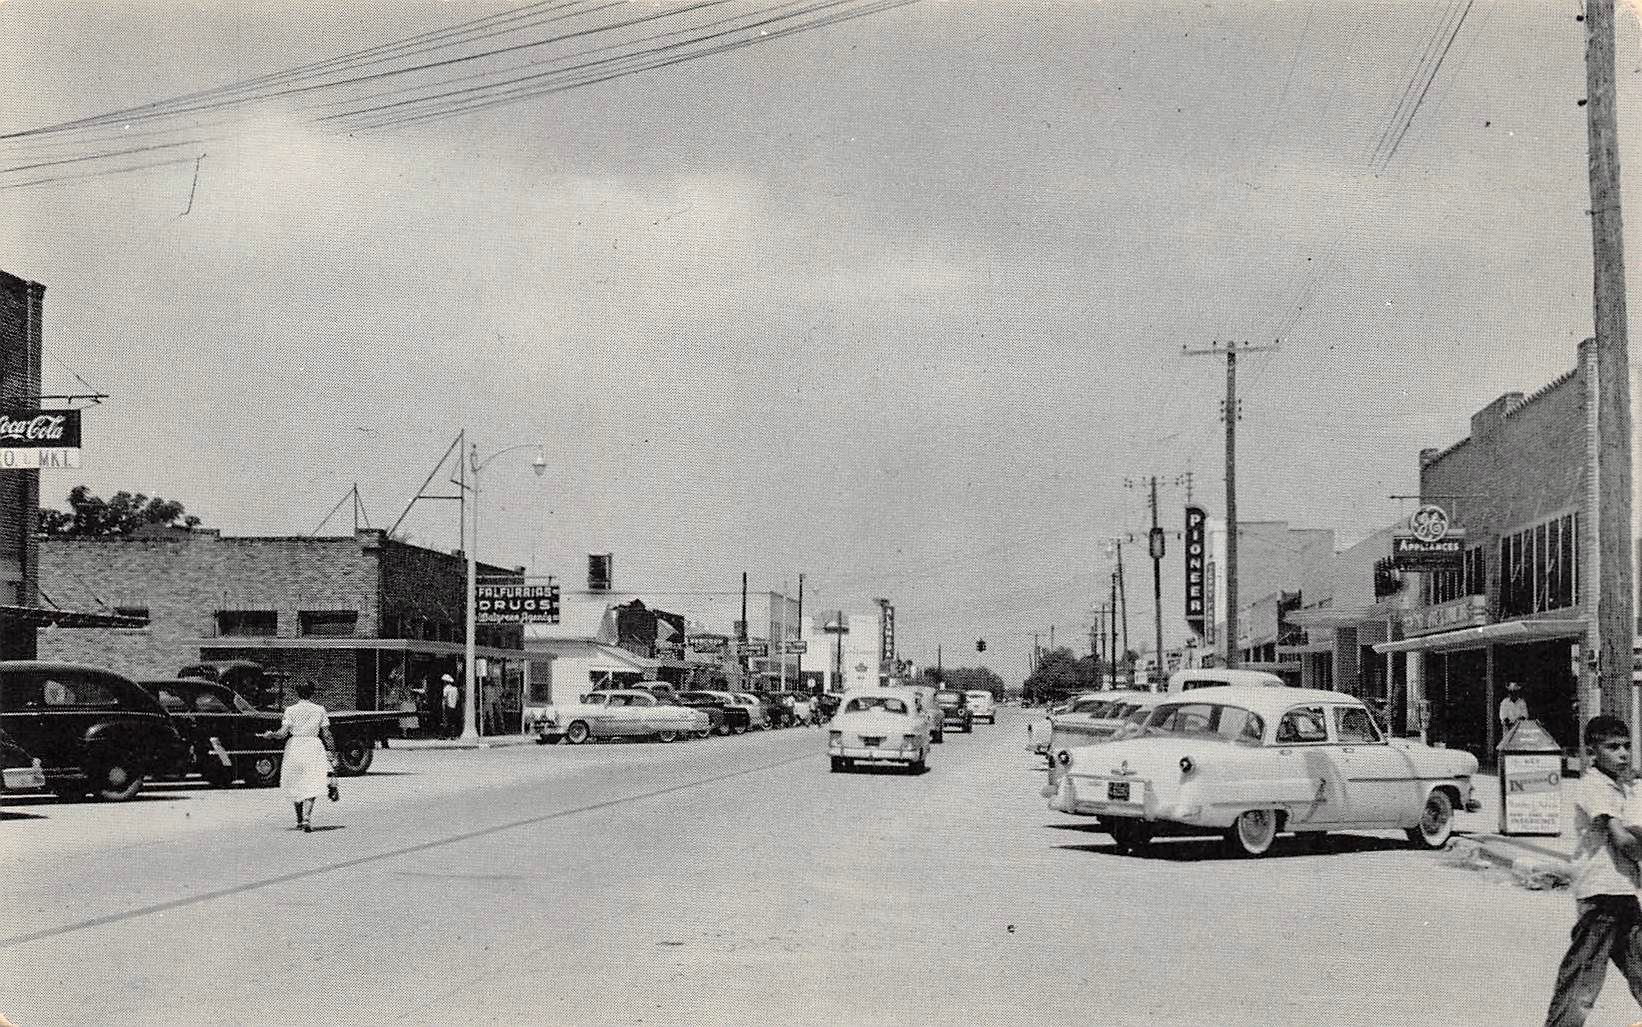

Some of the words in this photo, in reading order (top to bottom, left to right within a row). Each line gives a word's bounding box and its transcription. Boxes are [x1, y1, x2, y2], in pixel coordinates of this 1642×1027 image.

[1189, 513, 1201, 612] PIONEER
[478, 586, 552, 598] FALFURRIAS
[479, 599, 551, 610] DRUGS
